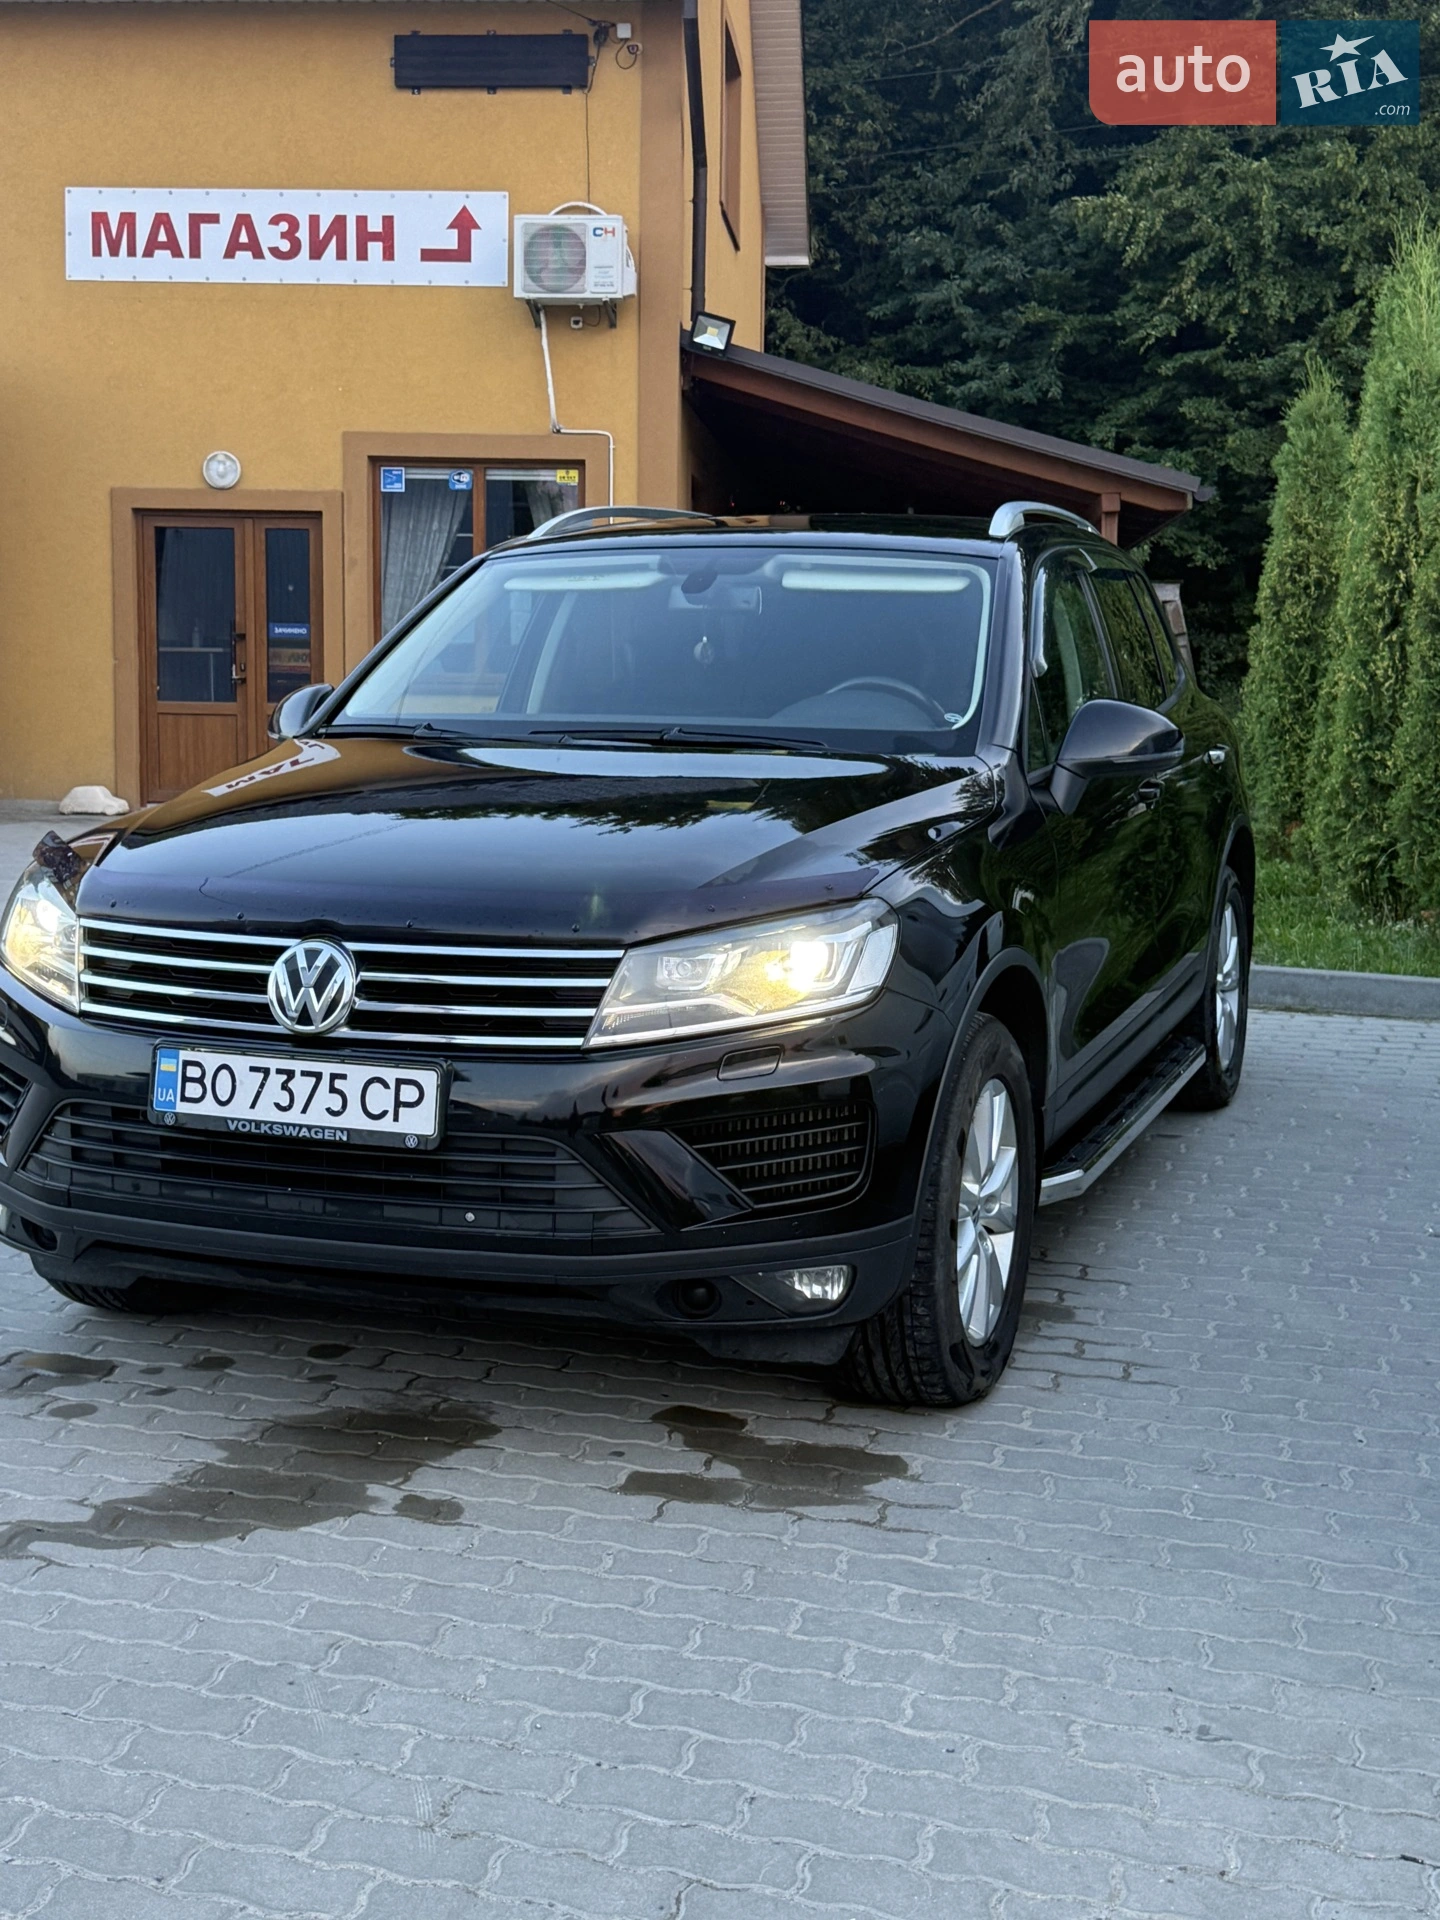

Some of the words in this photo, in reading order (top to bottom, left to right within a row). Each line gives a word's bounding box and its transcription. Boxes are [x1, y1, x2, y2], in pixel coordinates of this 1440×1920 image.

[91, 211, 396, 262] МАГАЗИН
[592, 226, 616, 238] CH
[157, 1087, 176, 1103] UA
[179, 1059, 237, 1107] BO
[248, 1065, 349, 1118] 7375
[360, 1076, 426, 1123] CP
[226, 1119, 349, 1142] VOLKSWAGEN
